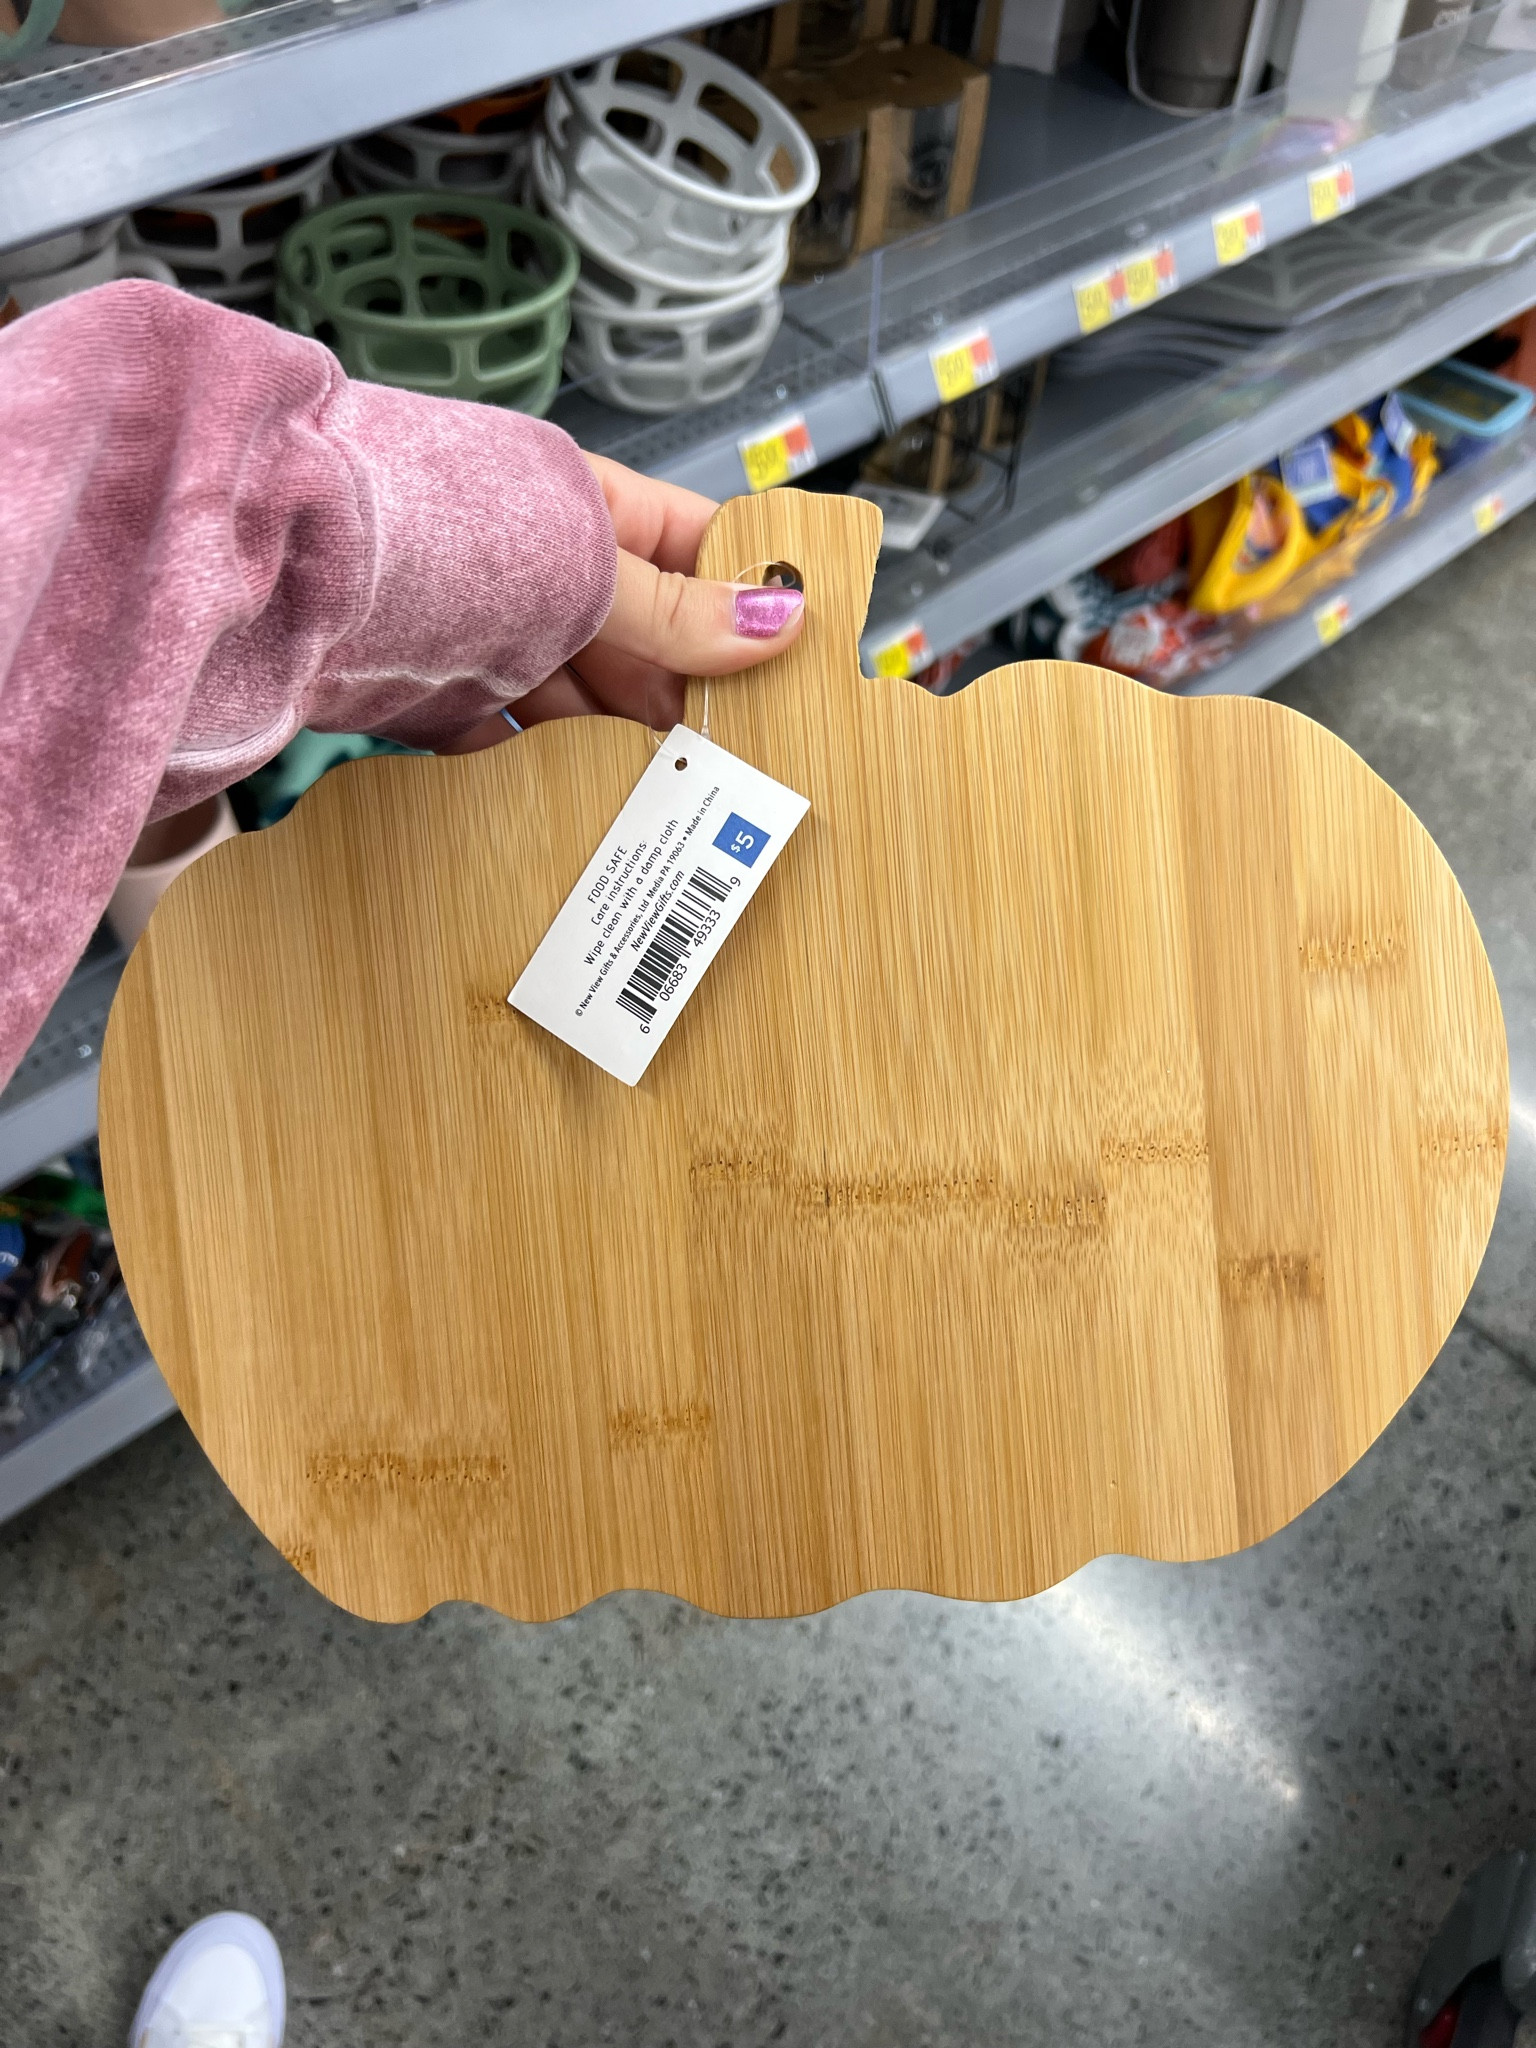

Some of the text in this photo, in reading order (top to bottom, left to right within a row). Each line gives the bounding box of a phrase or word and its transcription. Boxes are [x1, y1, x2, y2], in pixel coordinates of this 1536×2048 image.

[702, 786, 720, 807] China
[699, 807, 707, 816] in
[685, 815, 702, 836] Made
[666, 841, 685, 865] 19063
[731, 831, 755, 854] $5
[587, 845, 628, 904] FOOD SAFE
[660, 865, 671, 877] PA
[583, 819, 679, 965] Wipe clean with a damp cloth
[591, 840, 647, 926] Care instructions:
[646, 877, 664, 899] Media
[630, 870, 685, 952] NewViewGifts.com
[637, 899, 650, 913] Ltd
[613, 912, 644, 953] Accessories,
[610, 952, 618, 960] &
[639, 876, 741, 1034] 6 06683 49333 9
[600, 960, 614, 976] Gifts
[589, 976, 604, 993] View
[579, 994, 593, 1010] New
